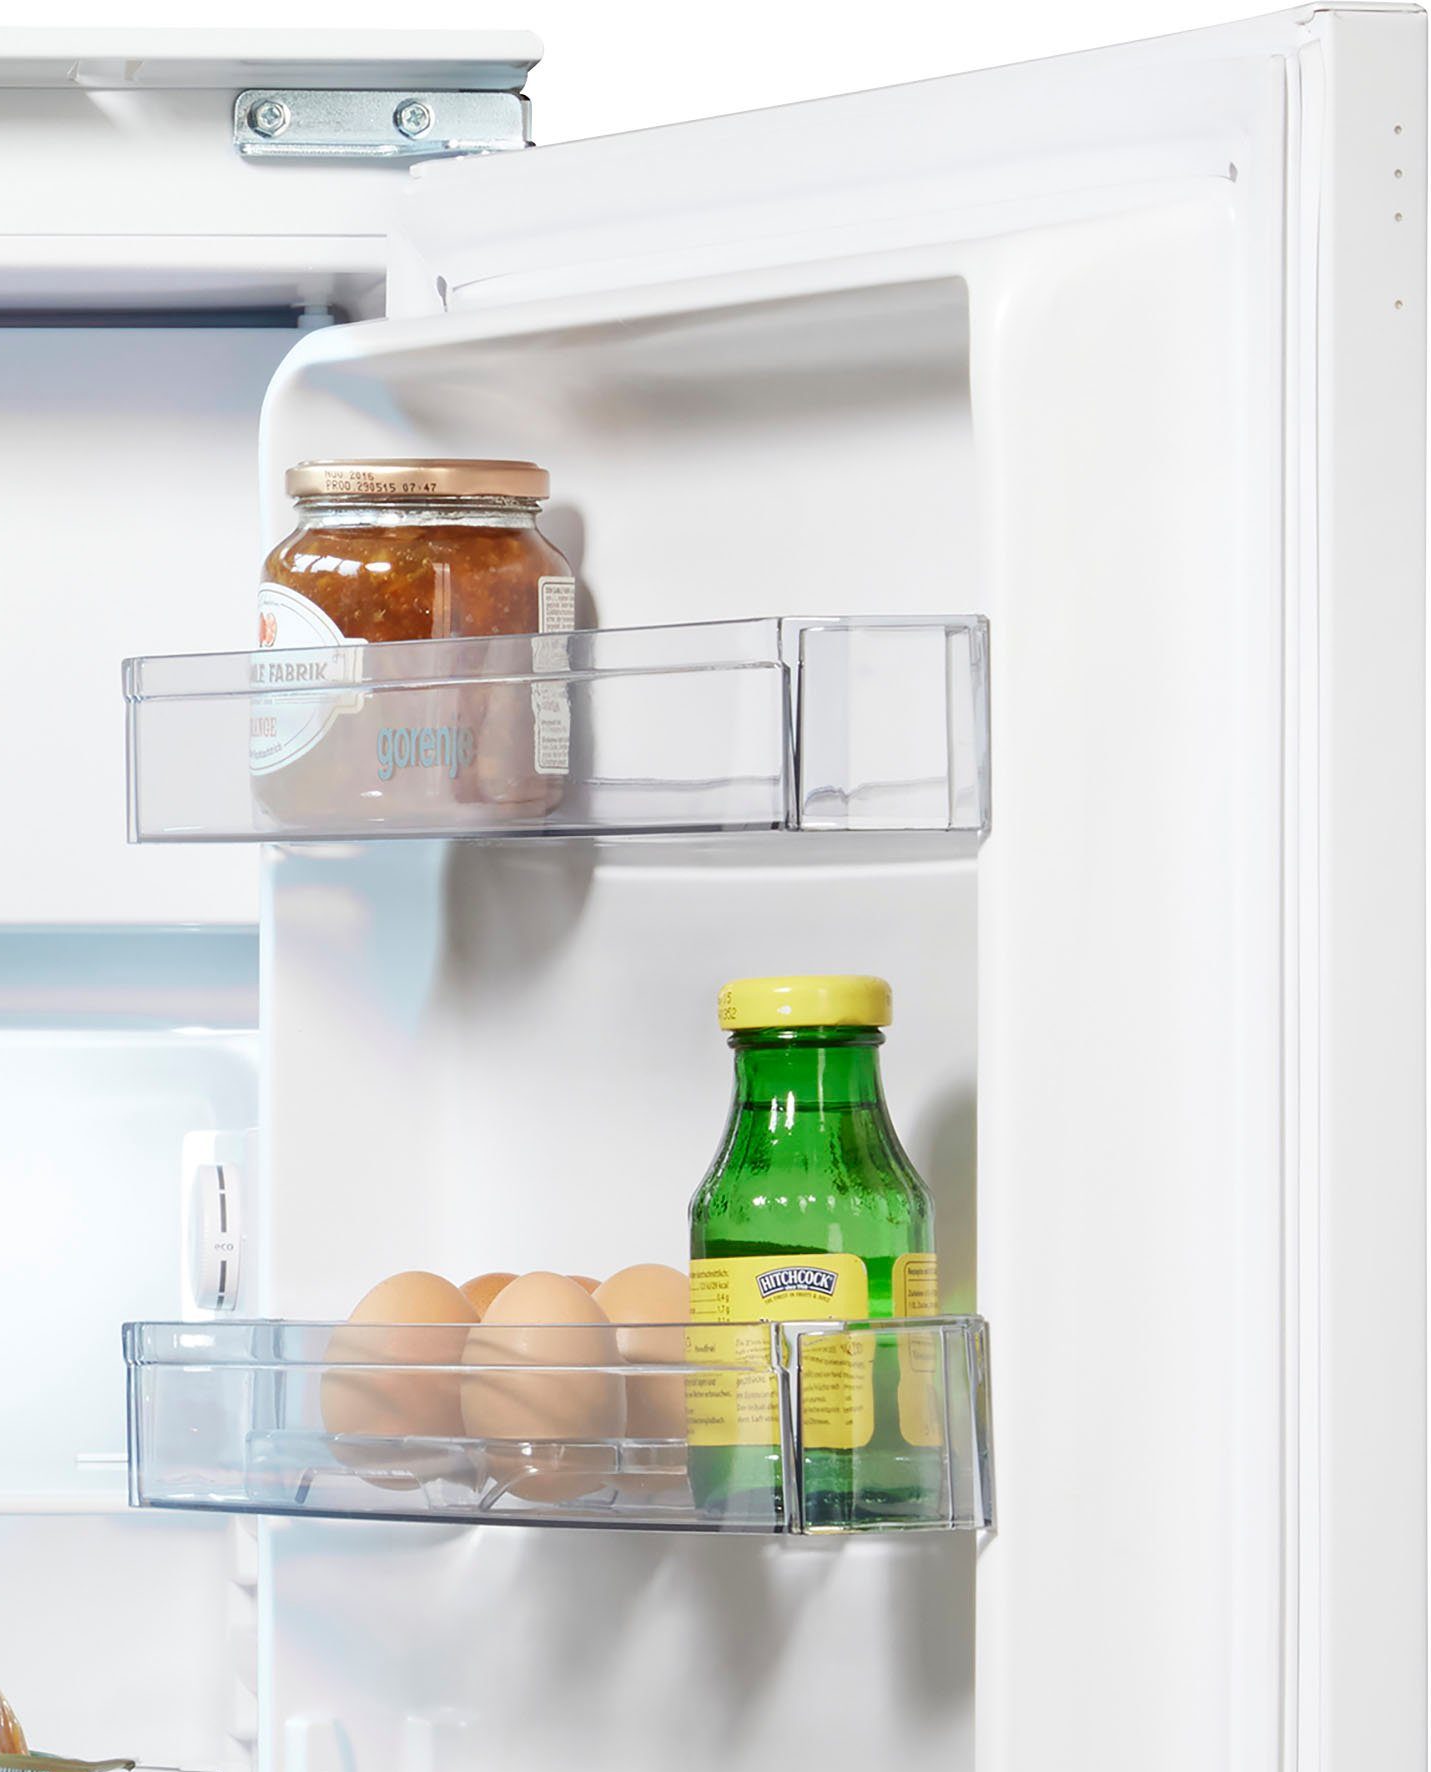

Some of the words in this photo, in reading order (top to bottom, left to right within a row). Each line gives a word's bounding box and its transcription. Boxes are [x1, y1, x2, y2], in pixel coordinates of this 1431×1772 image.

[269, 662, 328, 682] FABRIK
[376, 720, 476, 781] gorenje
[760, 1268, 830, 1293] HITCHCOCK
